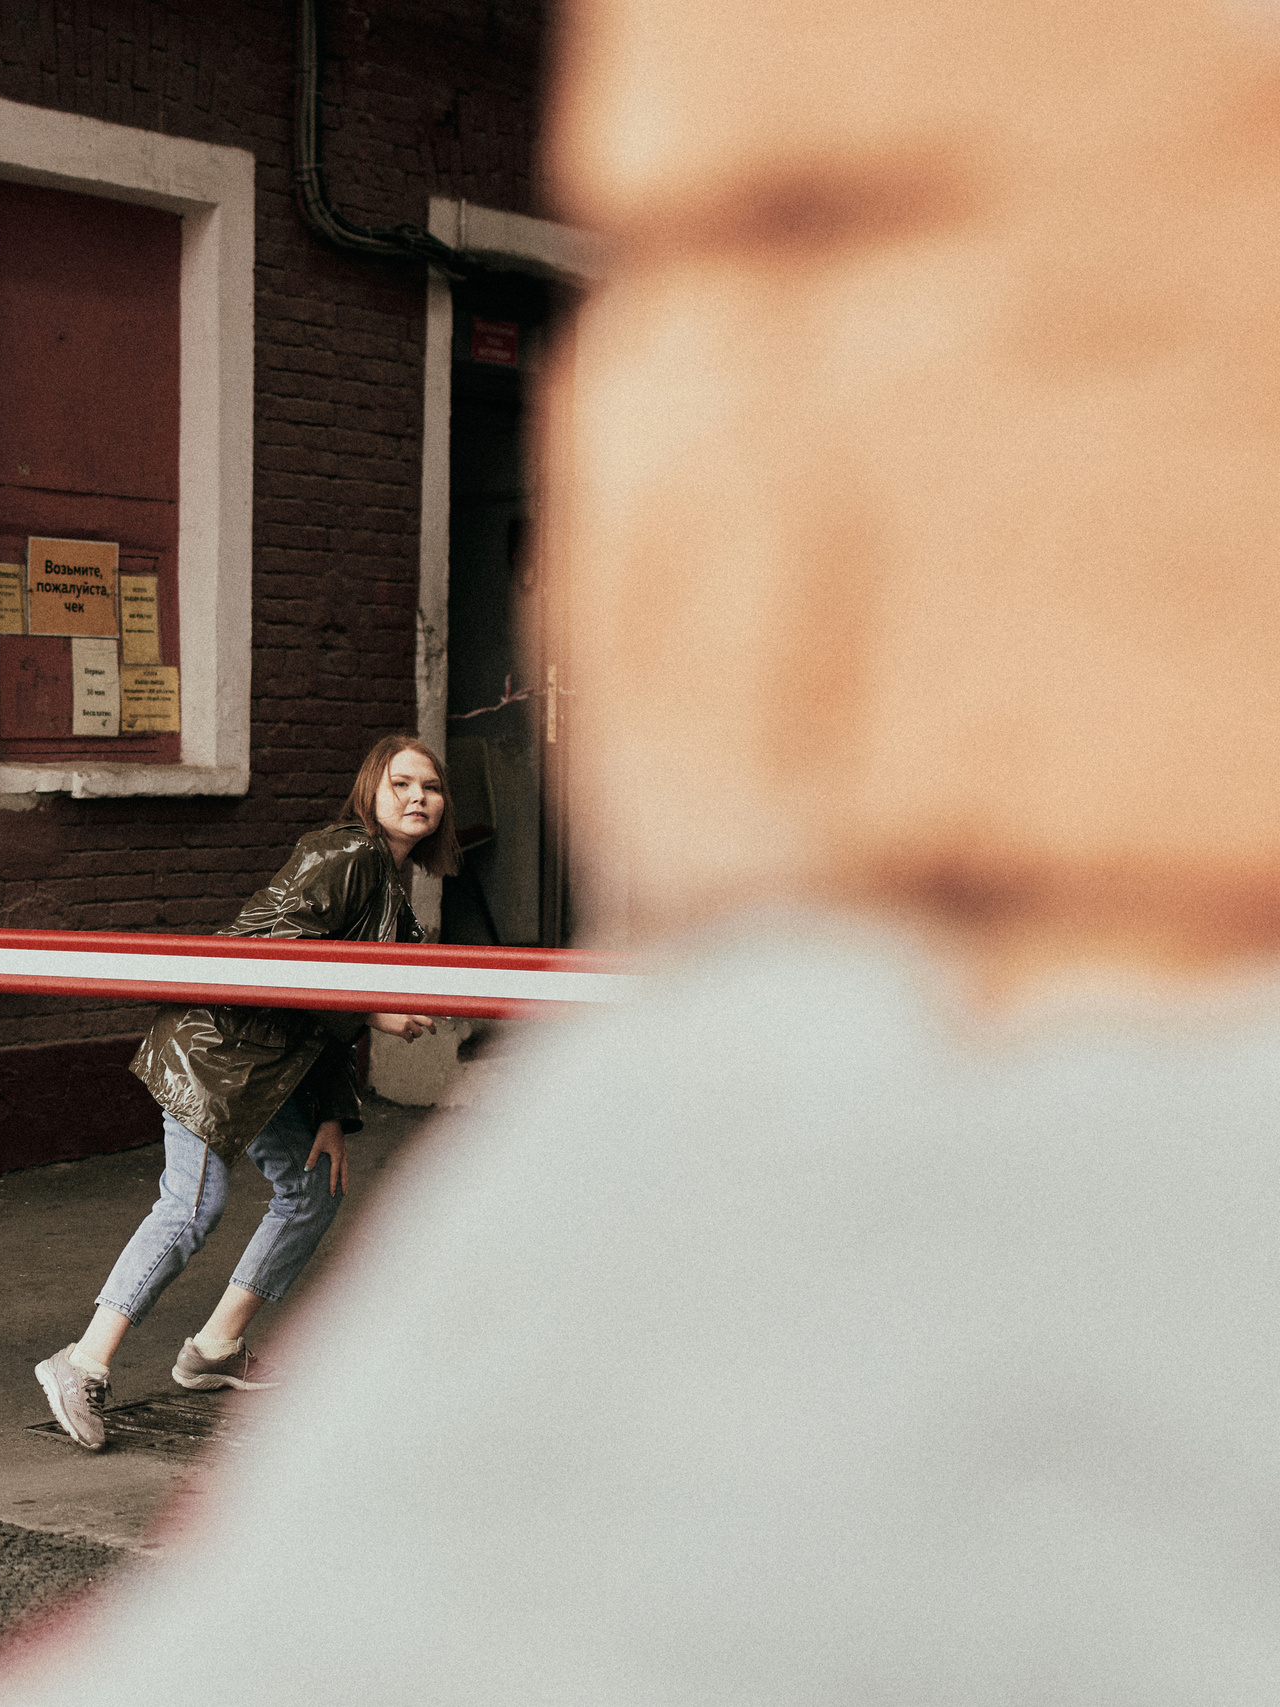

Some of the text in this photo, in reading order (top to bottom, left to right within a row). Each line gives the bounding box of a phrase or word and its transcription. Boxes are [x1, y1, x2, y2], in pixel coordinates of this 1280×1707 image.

[45, 559, 103, 580] Возьмите,
[36, 581, 110, 599] пожалуйста,
[64, 602, 85, 613] чек
